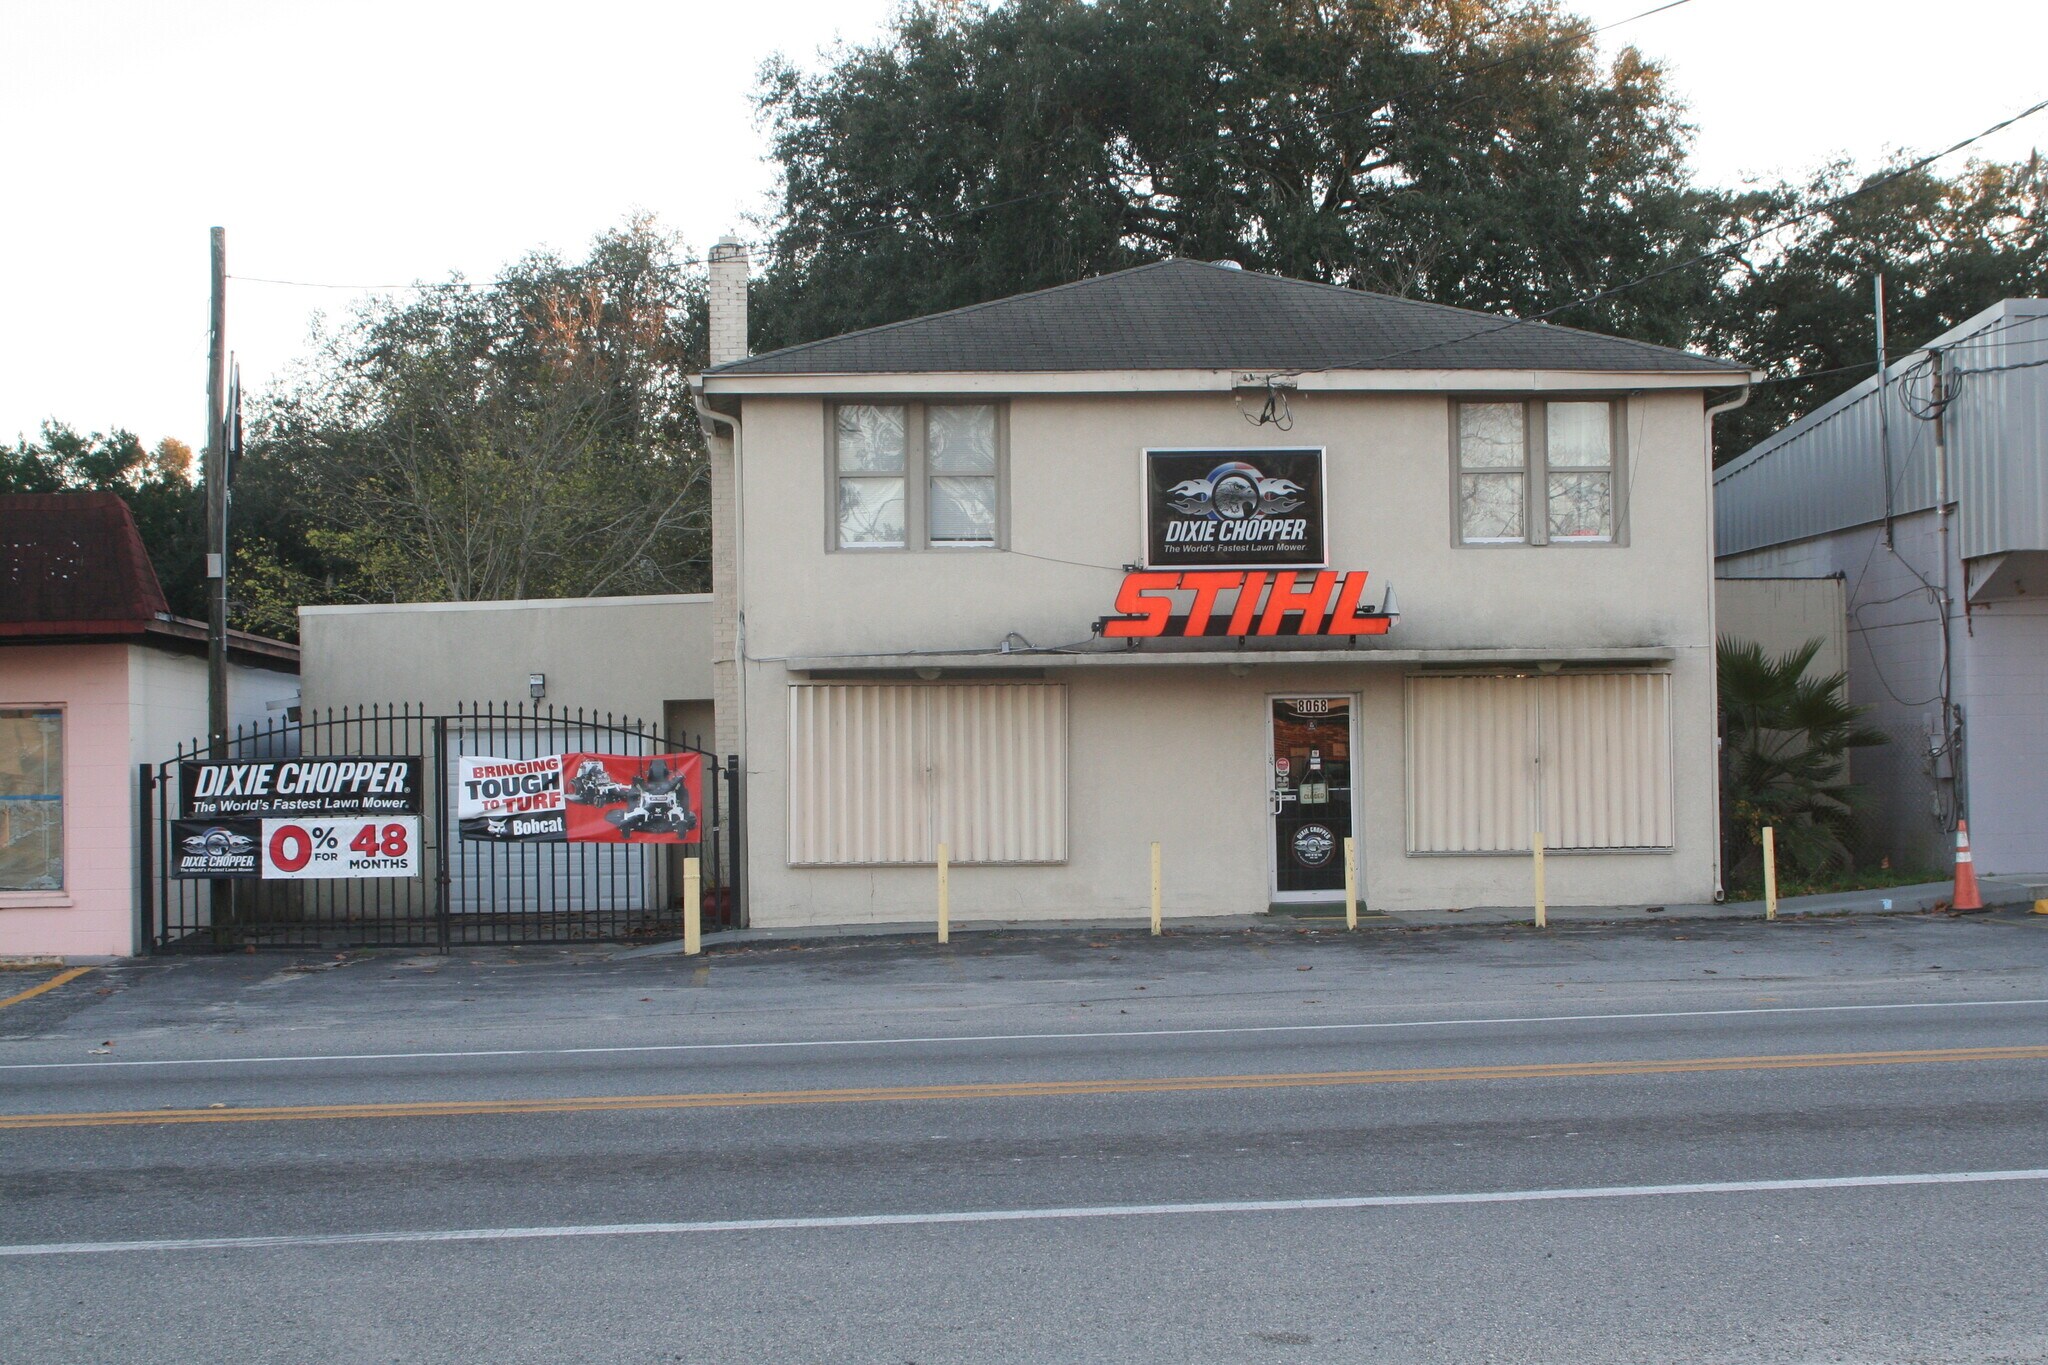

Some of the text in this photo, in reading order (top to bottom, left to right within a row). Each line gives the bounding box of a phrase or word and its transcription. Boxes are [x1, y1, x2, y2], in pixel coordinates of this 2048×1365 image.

[1165, 519, 1307, 542] DIXIE CHOPPER
[1164, 544, 1181, 553] The
[1182, 544, 1215, 553] World's
[1217, 543, 1249, 552] Fastest
[1250, 543, 1274, 552] Lawn
[1102, 570, 1391, 638] STIHL
[1298, 700, 1327, 712] 8068
[472, 758, 559, 778] BRINGING
[194, 762, 408, 798] DIXIE CHOPPER
[465, 771, 560, 800] TOUGH
[192, 801, 217, 813] The
[219, 799, 270, 812] World's
[272, 798, 323, 810] Fastest
[324, 798, 359, 809] Lawn
[482, 791, 561, 813] TO TURF
[512, 816, 563, 836] Bobcat
[349, 823, 408, 858] 48
[181, 855, 255, 867] DIXIE CHOPPER
[314, 852, 408, 870] FOR MONTHS
